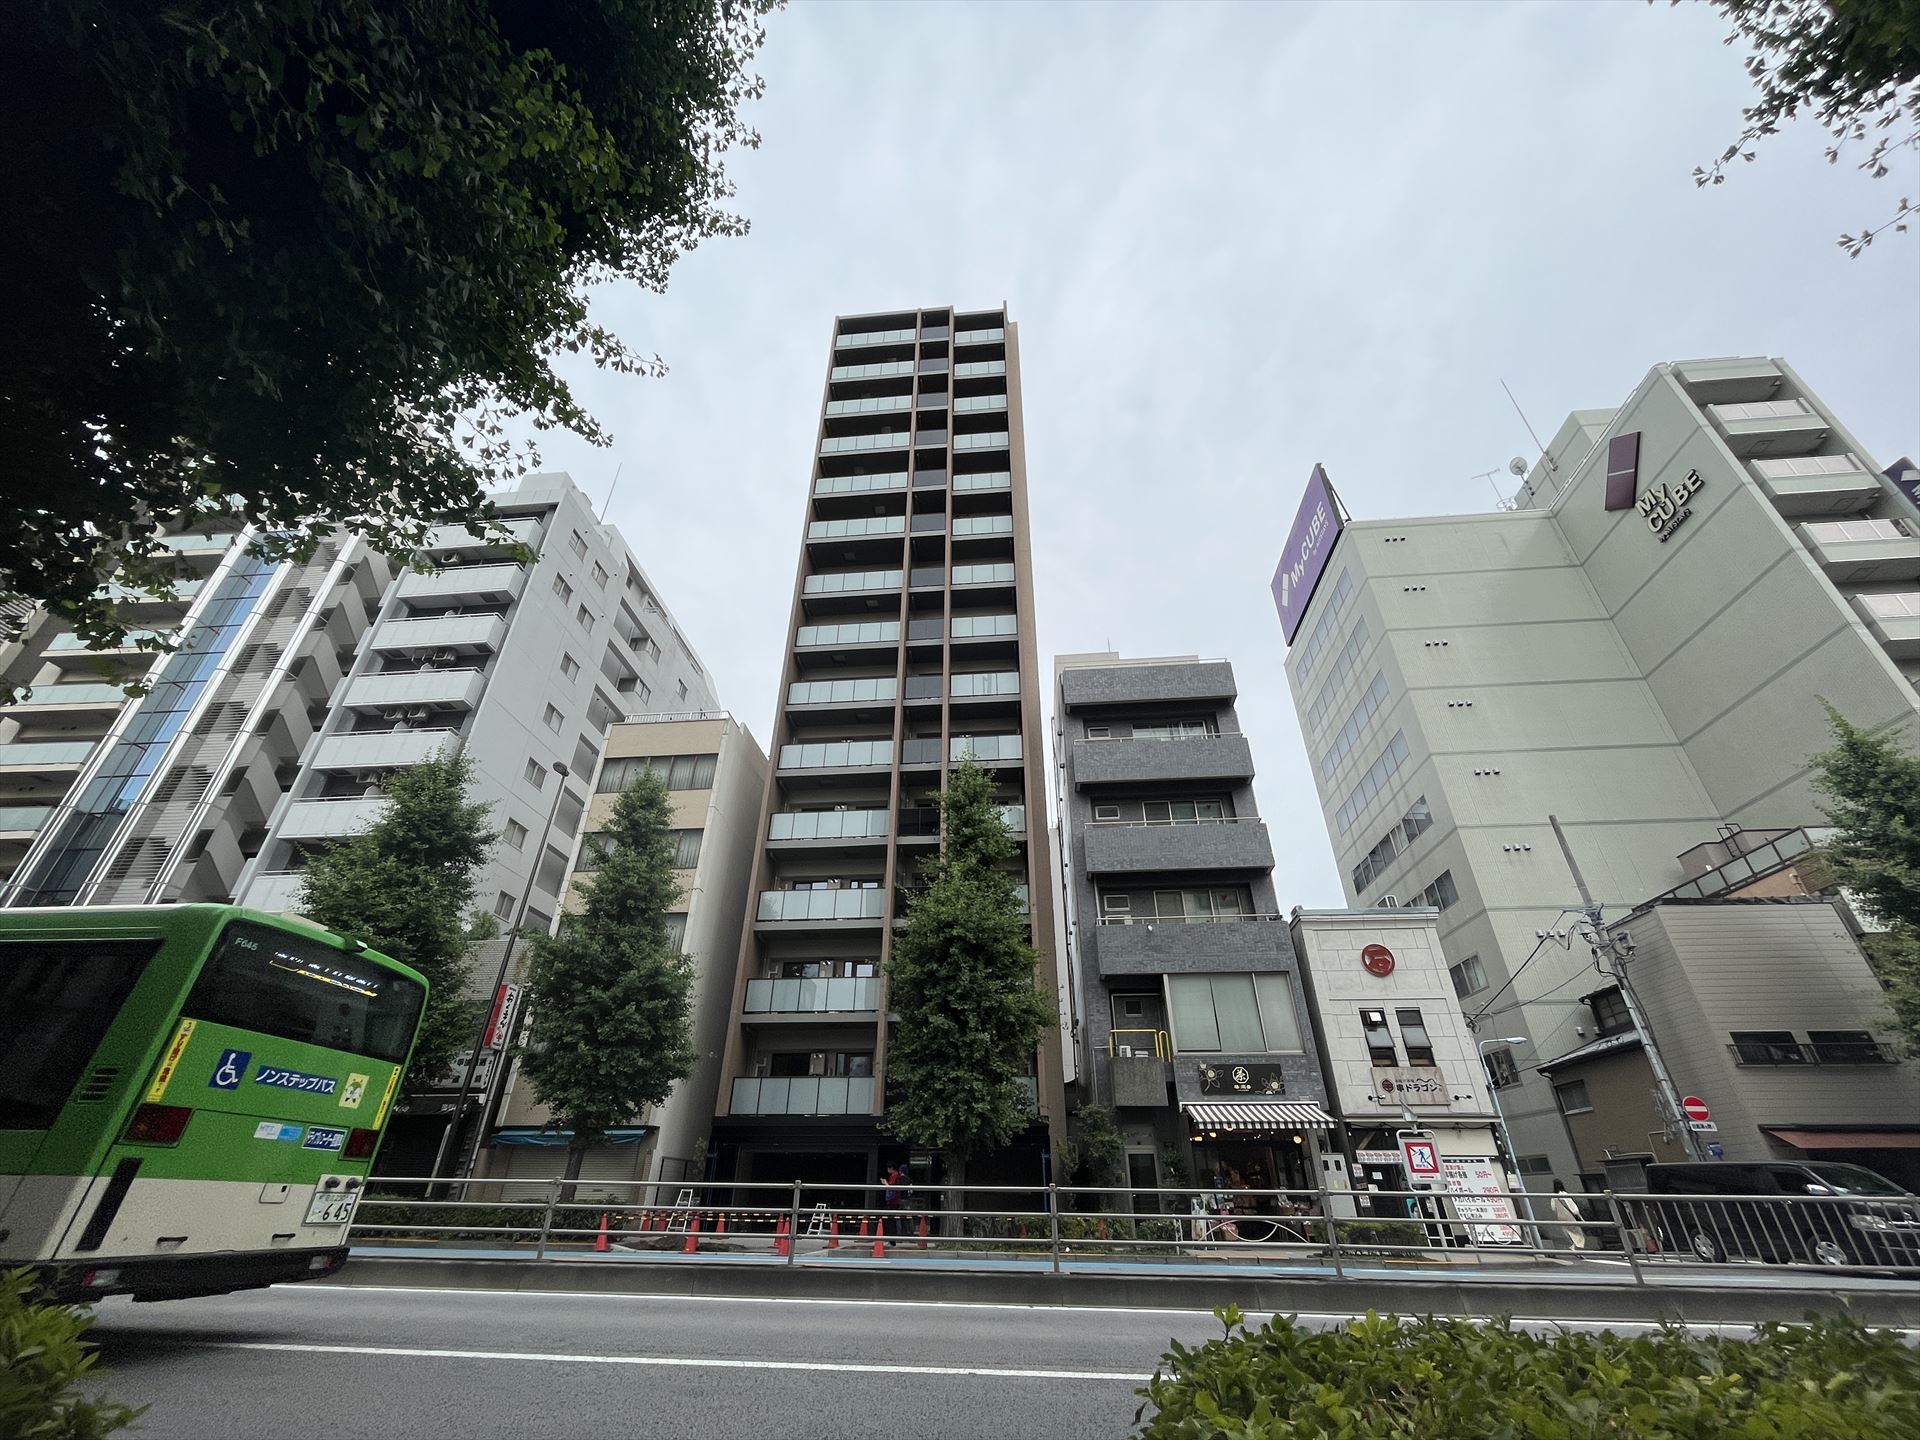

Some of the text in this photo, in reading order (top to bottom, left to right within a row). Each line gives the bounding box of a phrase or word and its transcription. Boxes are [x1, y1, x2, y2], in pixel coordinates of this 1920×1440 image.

[1647, 468, 1705, 533] CUBE
[1289, 501, 1326, 588] MyCUBE
[235, 937, 259, 951] F645
[256, 1069, 336, 1093] ノンステップバス
